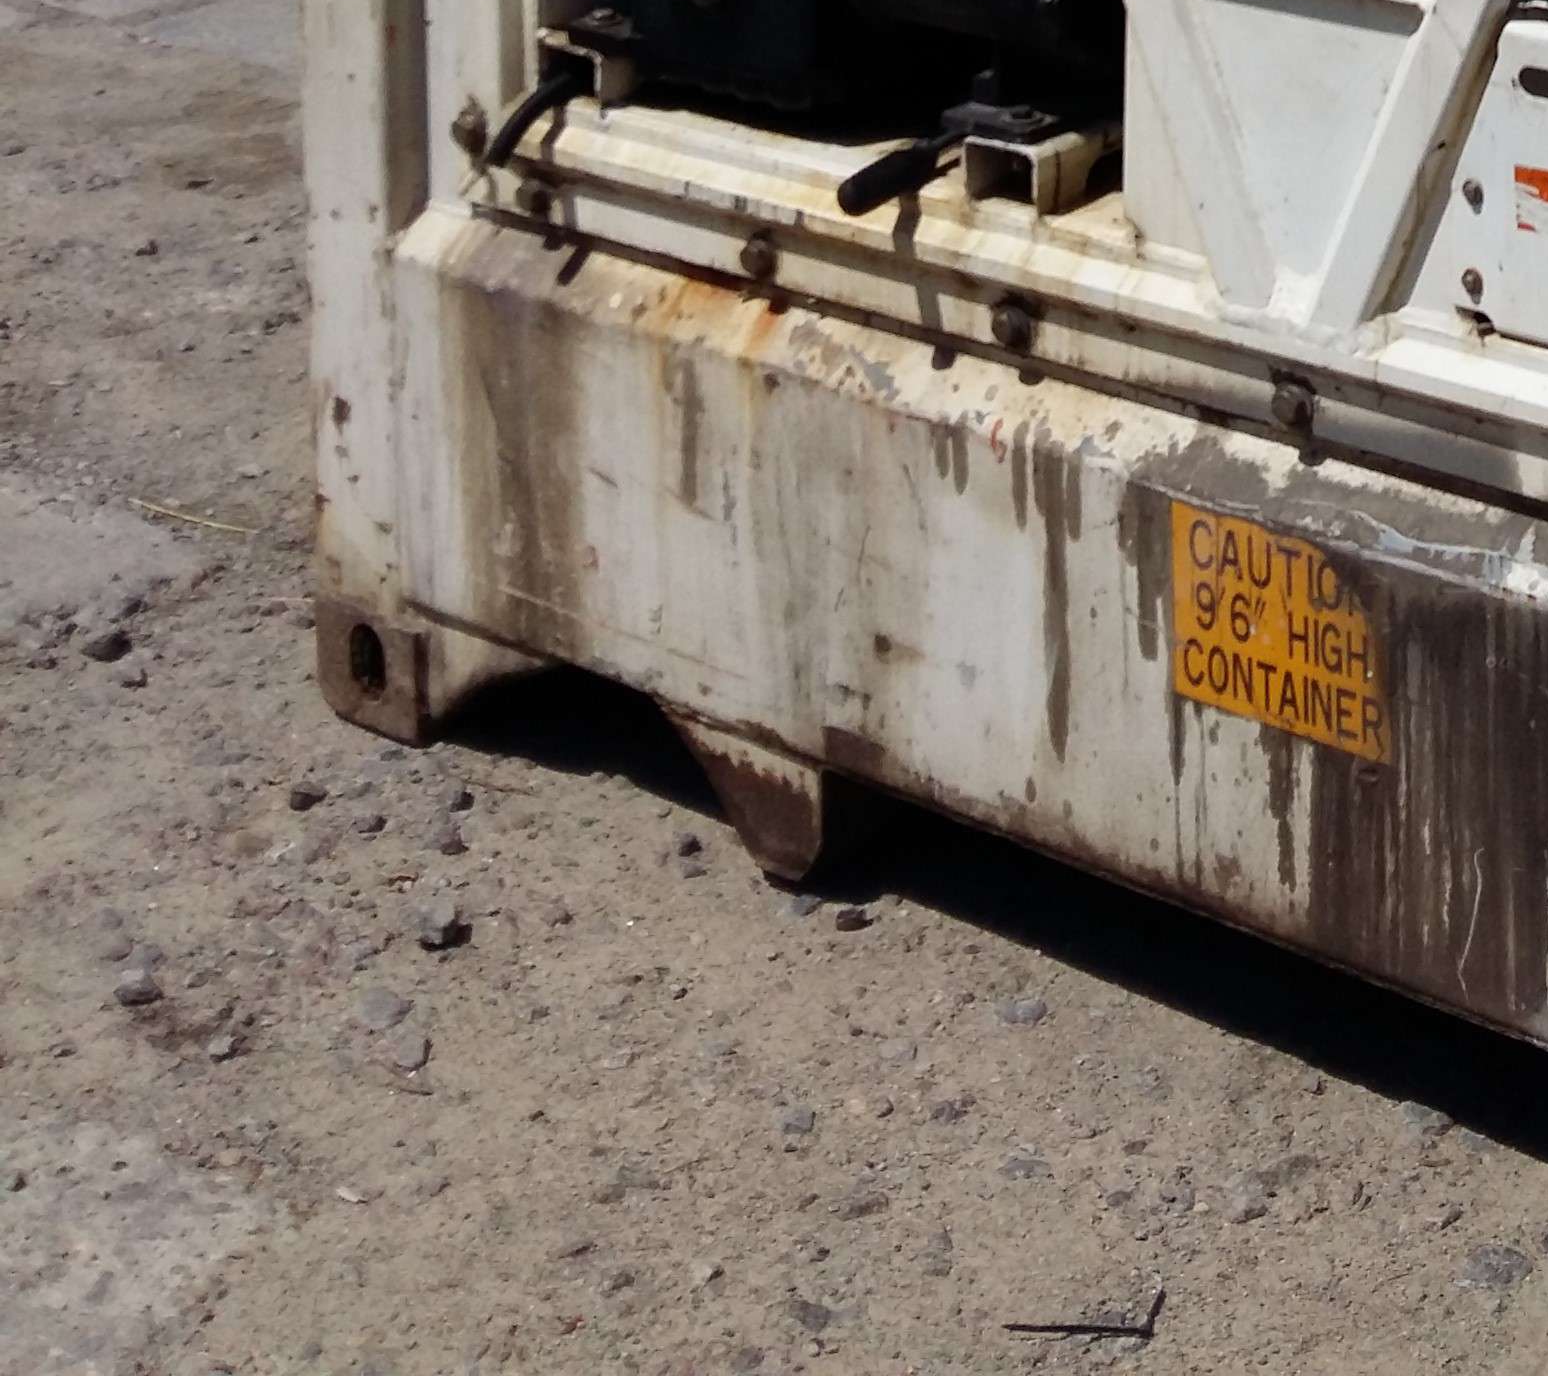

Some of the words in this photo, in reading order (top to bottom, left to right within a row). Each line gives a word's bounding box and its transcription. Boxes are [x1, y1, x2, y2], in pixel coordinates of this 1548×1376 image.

[1189, 519, 1354, 617] CAUTIO
[1183, 638, 1384, 746] CONTAINER
[1287, 610, 1369, 685] HIGH
